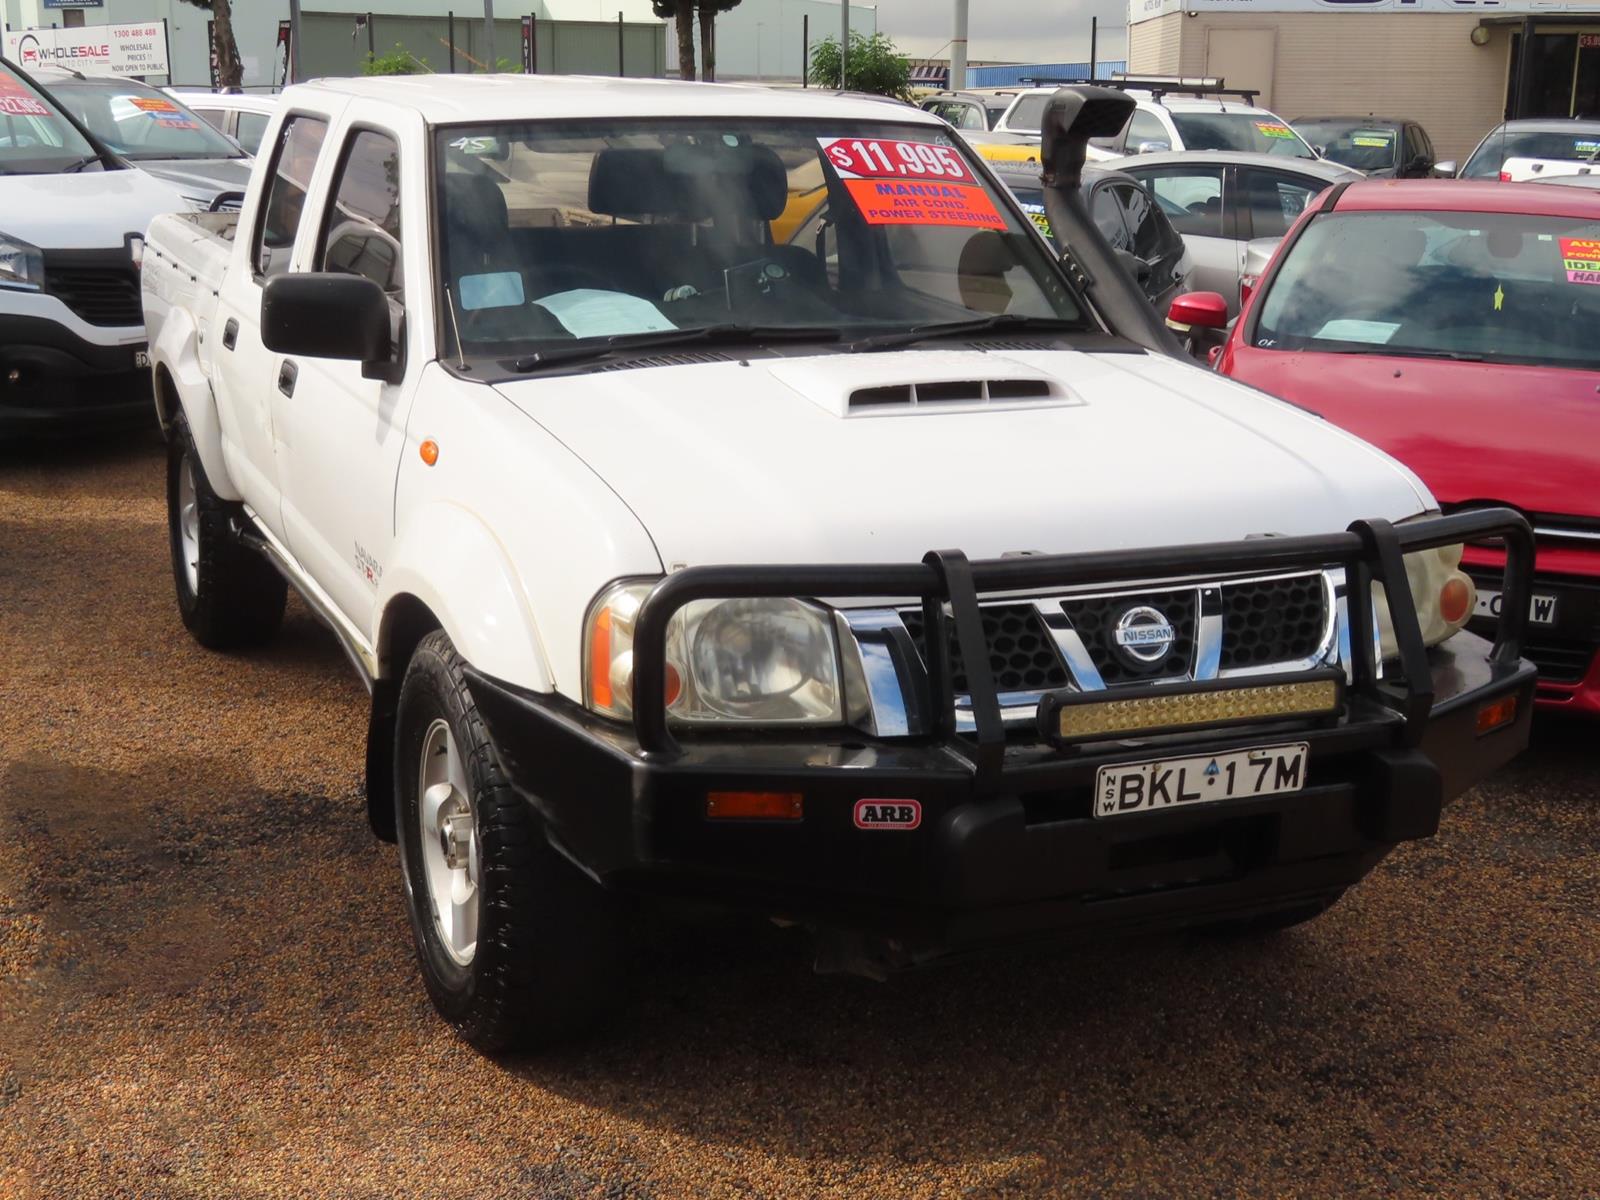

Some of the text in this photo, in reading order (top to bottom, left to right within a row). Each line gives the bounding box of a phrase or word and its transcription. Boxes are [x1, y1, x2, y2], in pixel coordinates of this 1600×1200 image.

[114, 30, 129, 38] 1300
[39, 45, 109, 59] WHOLESALE
[120, 43, 153, 51] WHOLESALE
[125, 64, 139, 72] OPEN
[147, 63, 165, 71] PUBLIC
[831, 141, 964, 178] $11,995
[875, 183, 966, 199] MANUAL
[894, 199, 969, 210] AIR COND.
[869, 209, 1001, 224] POWER STEERING
[1567, 261, 1600, 270] IDE
[1123, 629, 1171, 642] NISSAN
[862, 805, 914, 822] ARB
